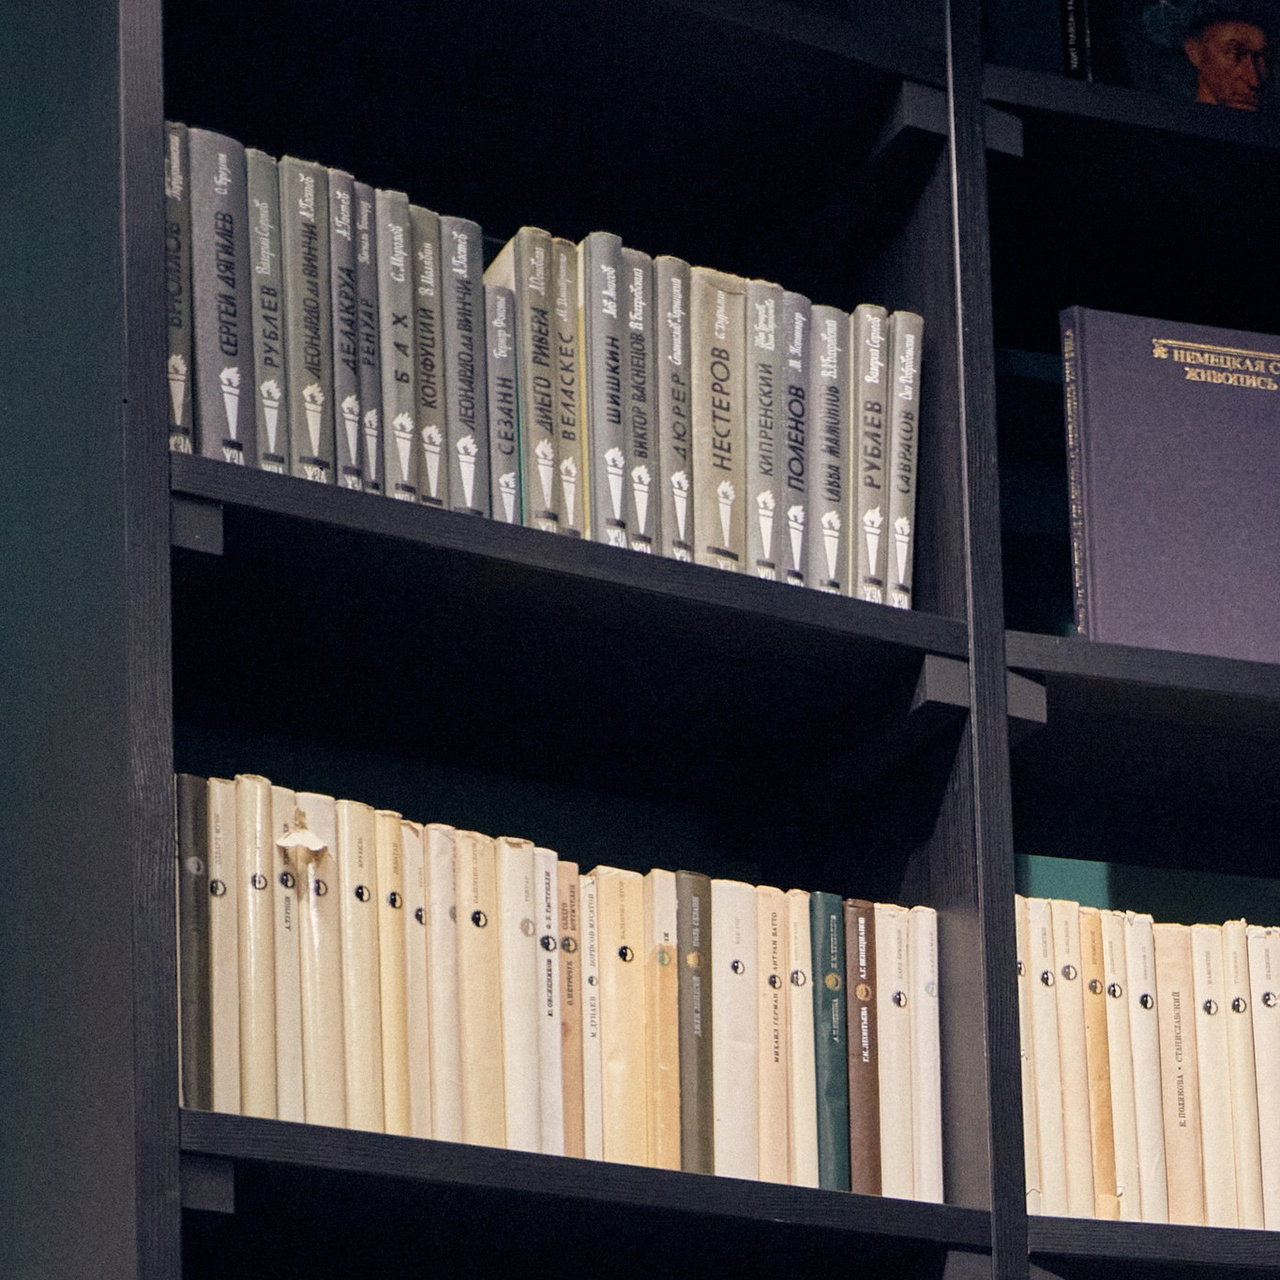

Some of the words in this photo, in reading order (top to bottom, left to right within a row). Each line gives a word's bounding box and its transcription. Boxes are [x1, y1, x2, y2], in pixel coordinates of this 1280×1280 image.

[215, 213, 236, 290] ДЯГИЛЕВ
[217, 295, 238, 356] СЕРГЕЙ
[263, 286, 279, 368] РУБЛЕВ
[417, 307, 437, 409] КОНФУЦИЙ
[530, 307, 549, 367] РИВЕРА
[1173, 349, 1265, 373] НЕМЕЦКАЯ
[496, 377, 515, 455] СЕЗАНН
[558, 331, 575, 440] ВЕЛАСКЕС
[607, 336, 621, 424] ШИШКИН
[671, 373, 688, 460] ДЮРЕР
[710, 347, 732, 471] НЕСТЕРОВ
[758, 363, 773, 477] КИПРЕНСКИЙ
[1184, 367, 1279, 391] ЖИВОПИСЬ
[788, 385, 805, 492] ПОЛЕНОВ
[864, 401, 881, 489] РУБЛЕВ
[900, 410, 912, 494] САВРАСОВ
[1172, 991, 1183, 1062] СТАНИСЛАВСКИЙ
[1177, 1074, 1186, 1118] ПОЛЯКОВА
